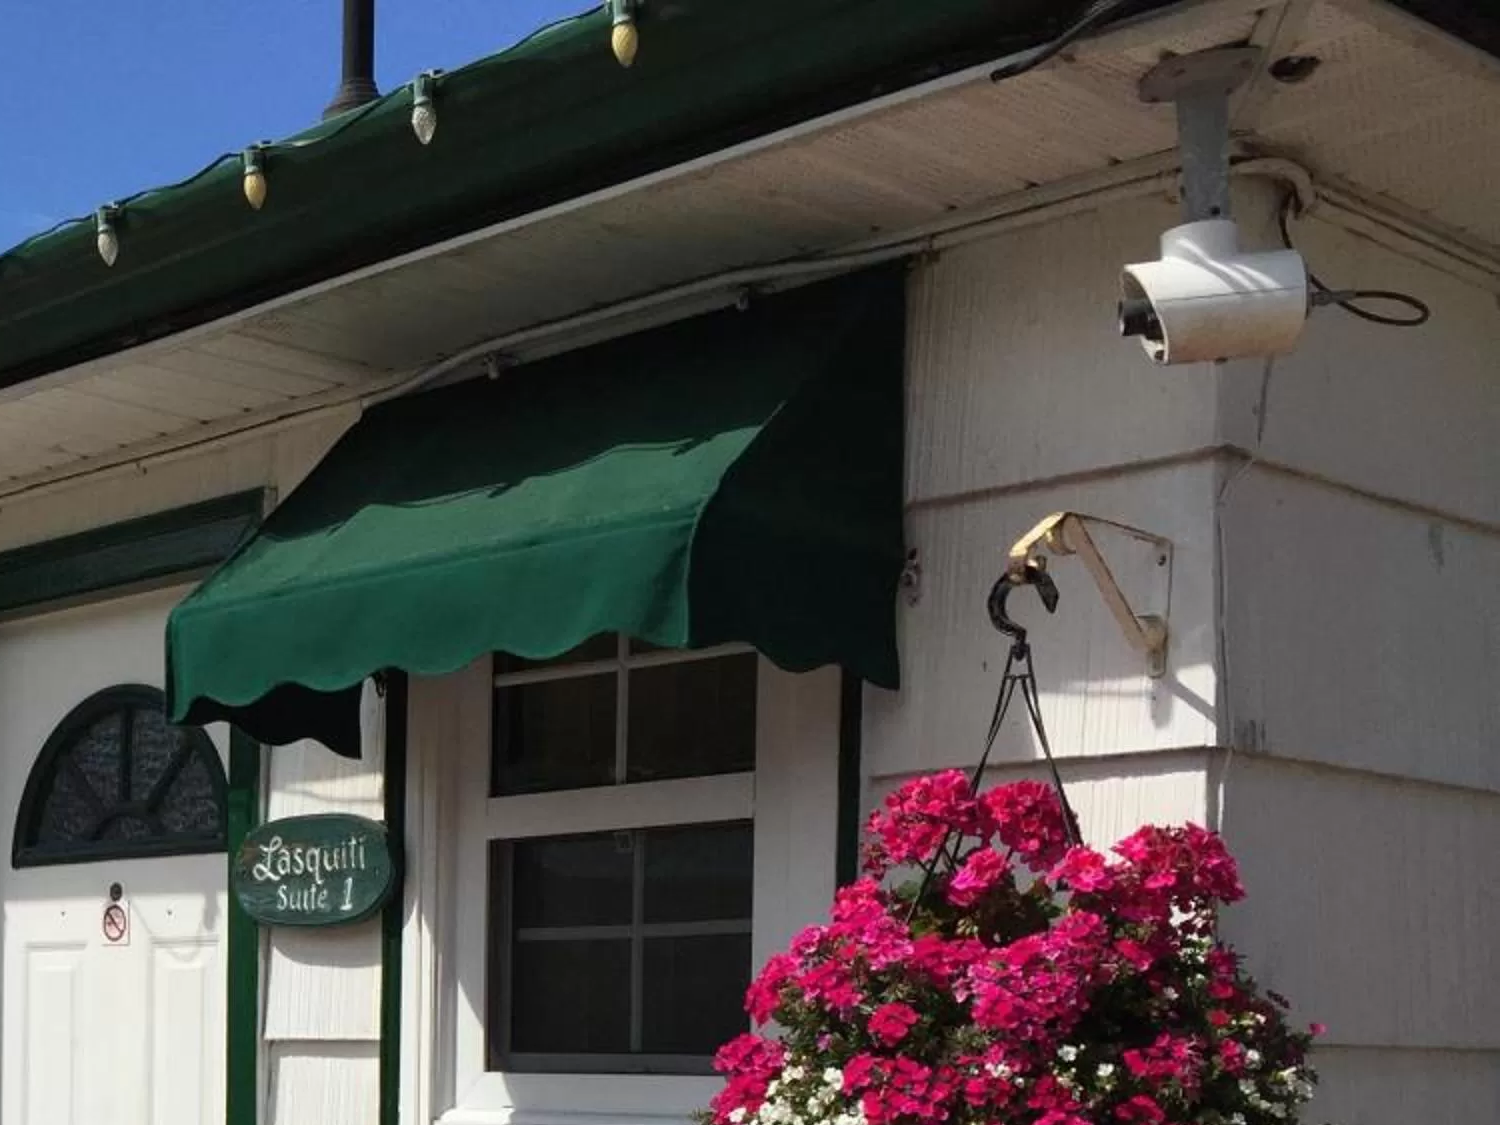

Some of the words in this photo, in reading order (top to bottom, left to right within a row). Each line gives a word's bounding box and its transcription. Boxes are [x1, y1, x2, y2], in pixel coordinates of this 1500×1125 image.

[252, 834, 366, 885] Lasquiti
[276, 884, 328, 911] Suite
[340, 877, 353, 911] 1
